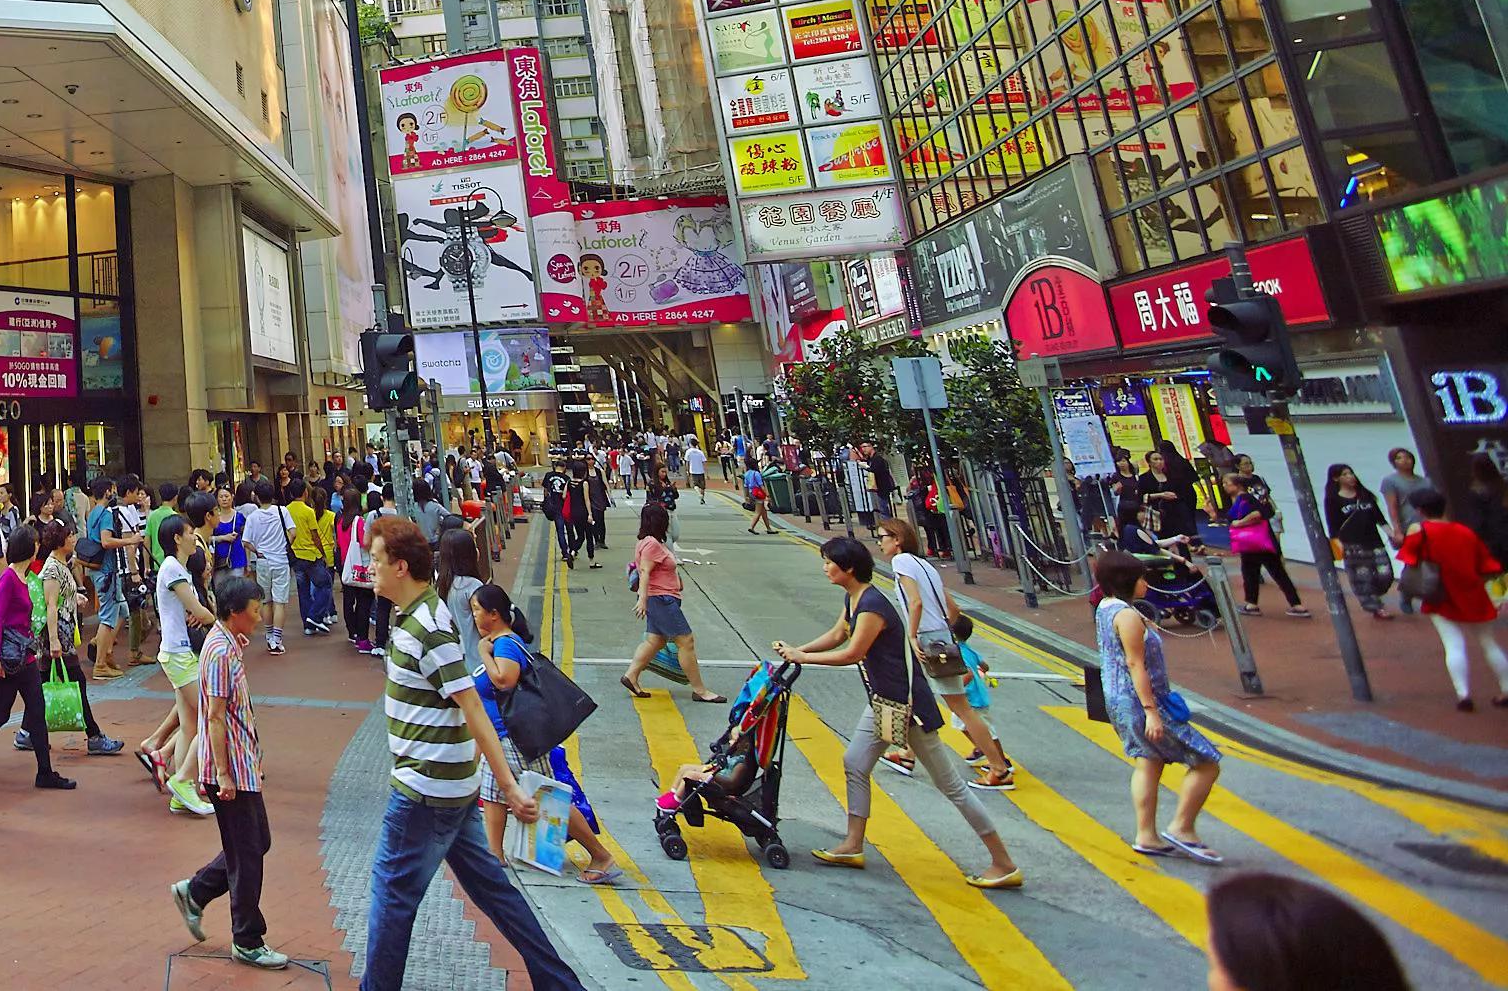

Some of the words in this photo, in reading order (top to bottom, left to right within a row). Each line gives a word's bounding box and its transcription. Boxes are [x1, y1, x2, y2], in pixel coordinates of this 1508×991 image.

[845, 41, 860, 50] 7/F
[514, 56, 541, 100] 東角
[770, 71, 786, 81] 6/F
[404, 81, 423, 94] 東角
[395, 92, 435, 109] Laforet
[850, 93, 871, 105] 5/F
[425, 111, 447, 126] 2/F
[424, 133, 438, 143] 1/F
[519, 101, 553, 178] Laforet
[432, 159, 442, 167] AD
[444, 156, 463, 166] HERE
[468, 152, 487, 162] 2864
[488, 149, 507, 158] 4247
[746, 143, 787, 159] 傷心
[452, 181, 481, 192] TISSOT
[788, 175, 803, 184] 5/F
[872, 188, 894, 203] 4/F
[759, 198, 880, 229] 花園餐廳
[595, 220, 622, 234] 東角
[583, 234, 638, 250] Laforet
[805, 234, 841, 247] Garden
[618, 261, 648, 279] 2/F
[617, 287, 635, 298] 1/F
[1134, 281, 1200, 332] 周大福
[615, 312, 629, 322] AD
[632, 311, 658, 321] HERE
[665, 310, 688, 320] 2864
[692, 310, 715, 319] 4247
[421, 358, 456, 368] swatch
[2, 372, 67, 390] 10%現金回贈
